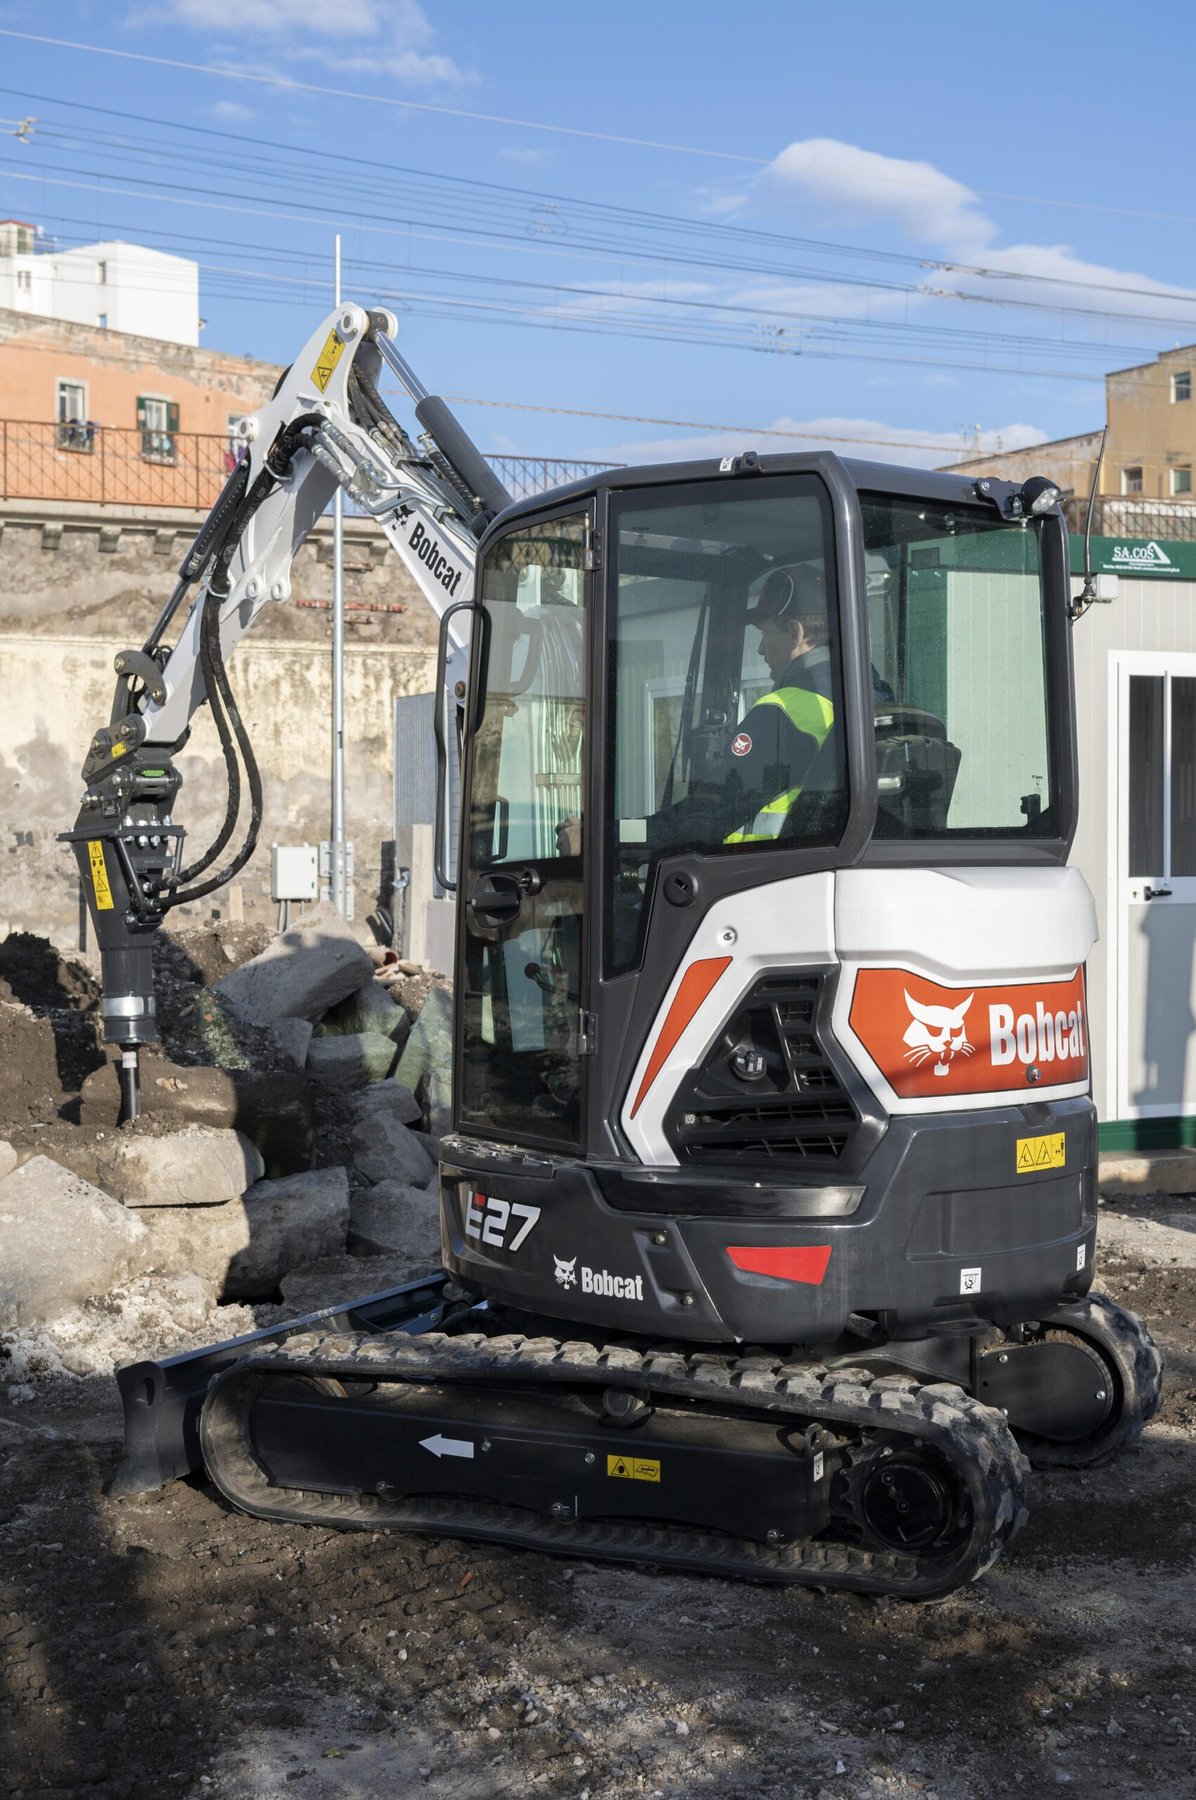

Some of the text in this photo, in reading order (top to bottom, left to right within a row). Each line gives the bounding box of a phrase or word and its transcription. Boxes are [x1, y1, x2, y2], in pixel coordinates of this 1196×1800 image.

[408, 521, 462, 597] Bobcat
[989, 1001, 1084, 1066] Bobcat
[465, 1190, 541, 1251] E27
[581, 1266, 643, 1300] Bobcat
